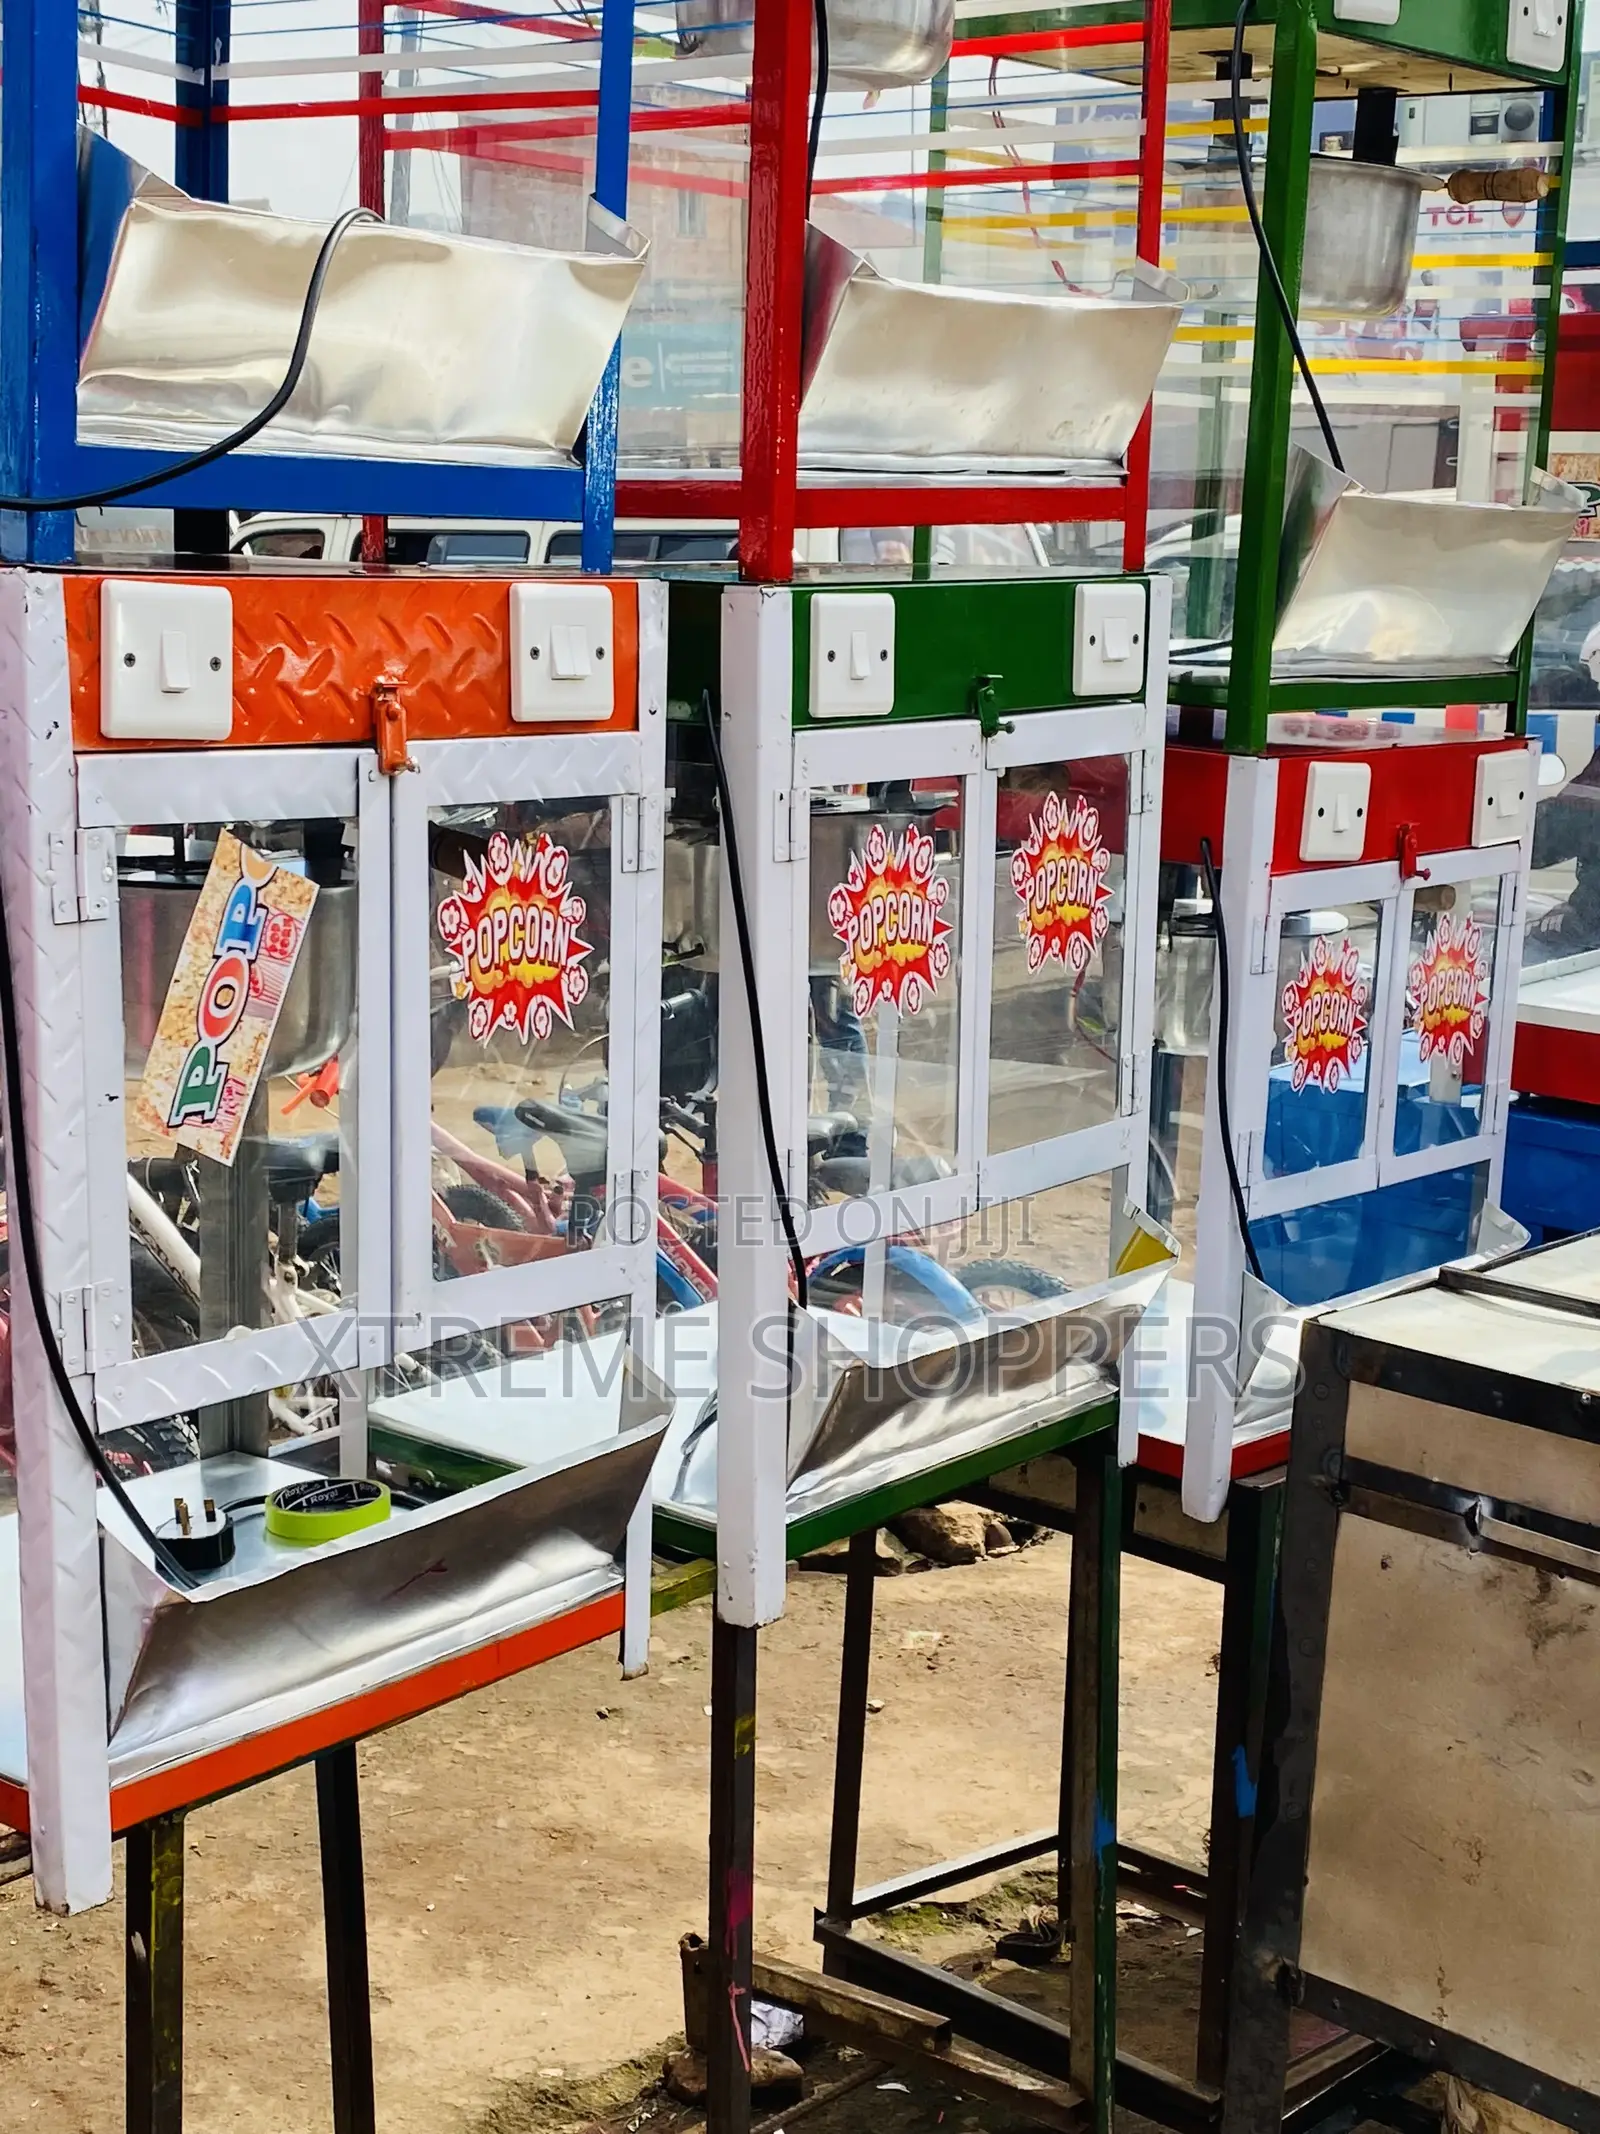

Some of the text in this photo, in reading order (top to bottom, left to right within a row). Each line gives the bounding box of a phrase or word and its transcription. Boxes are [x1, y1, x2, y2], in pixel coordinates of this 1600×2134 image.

[1426, 205, 1484, 226] TCL
[1025, 855, 1099, 920] POPCORN
[461, 903, 572, 981] POPCORN
[847, 890, 937, 963] POPCORN
[1293, 989, 1356, 1044] POPCORN
[1420, 966, 1479, 1020] POPCORN
[310, 1489, 339, 1504] Royal
